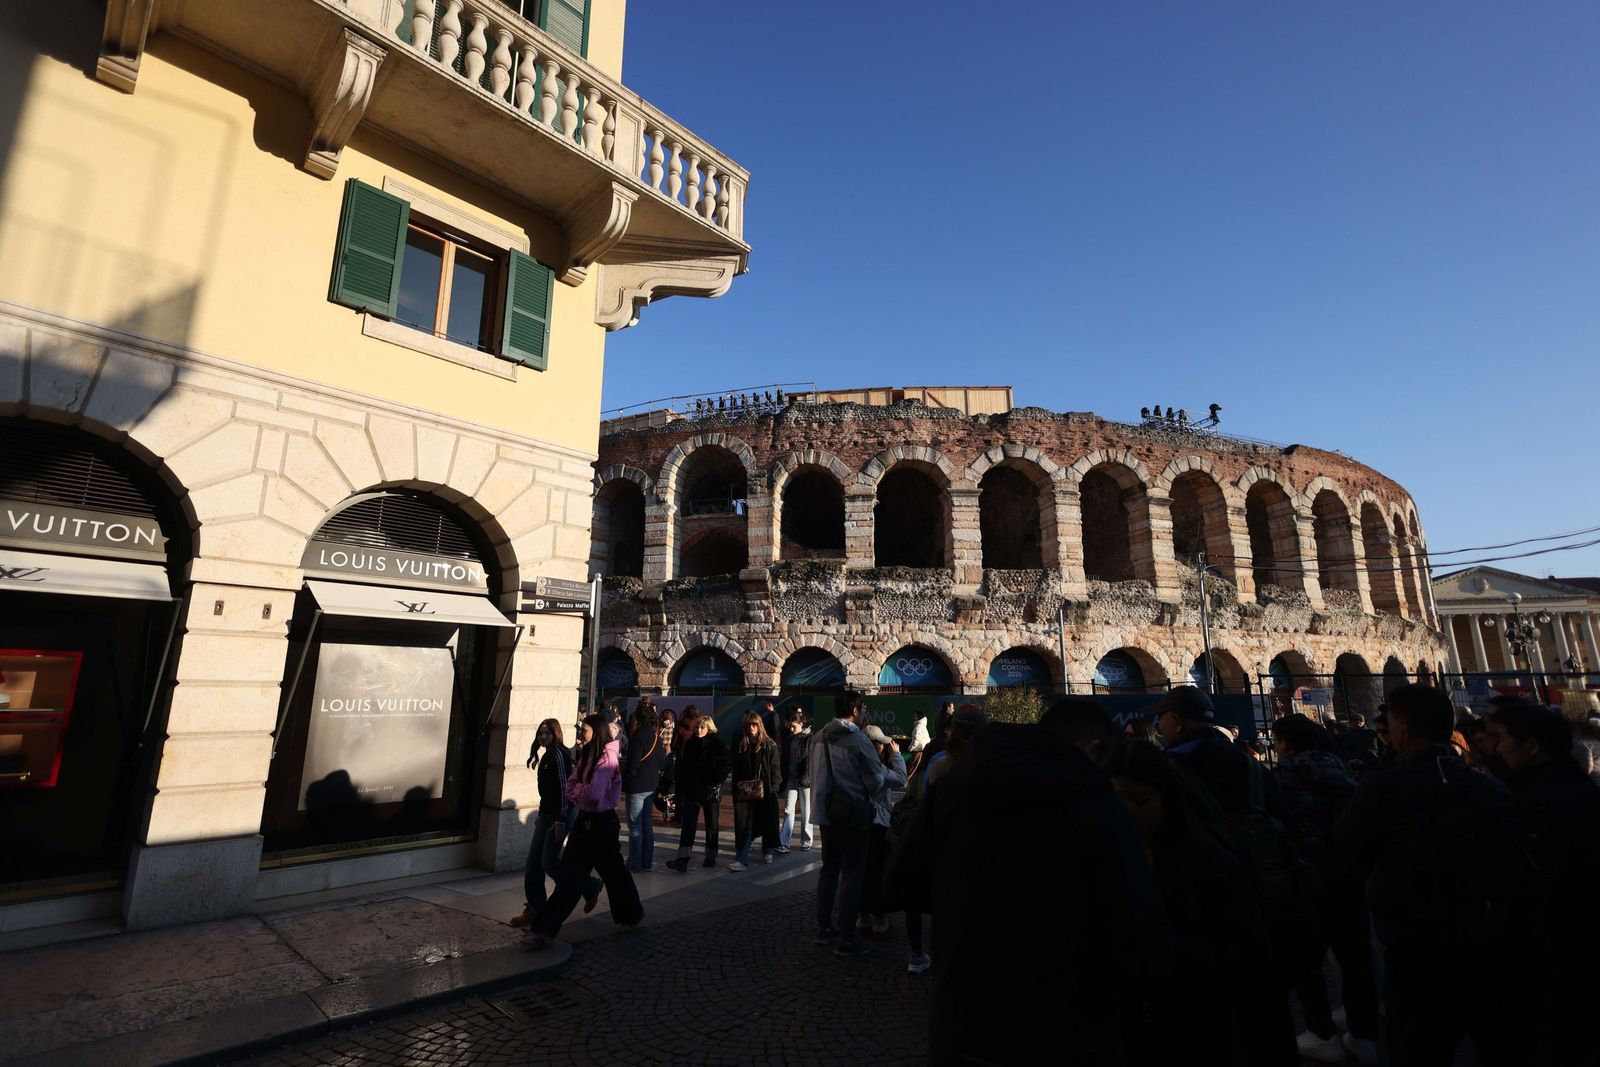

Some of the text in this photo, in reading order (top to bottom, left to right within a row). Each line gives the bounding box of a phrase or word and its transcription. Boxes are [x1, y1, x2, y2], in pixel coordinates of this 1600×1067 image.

[7, 509, 157, 547] VUITTON
[319, 549, 482, 582] LOUIS VUITTON
[709, 656, 715, 670] 1
[996, 657, 1026, 665] MILANO
[1001, 664, 1033, 672] CORTINA
[1007, 670, 1023, 678] 2026
[320, 697, 443, 713] LOUIS VUITTON
[864, 710, 896, 723] ANO
